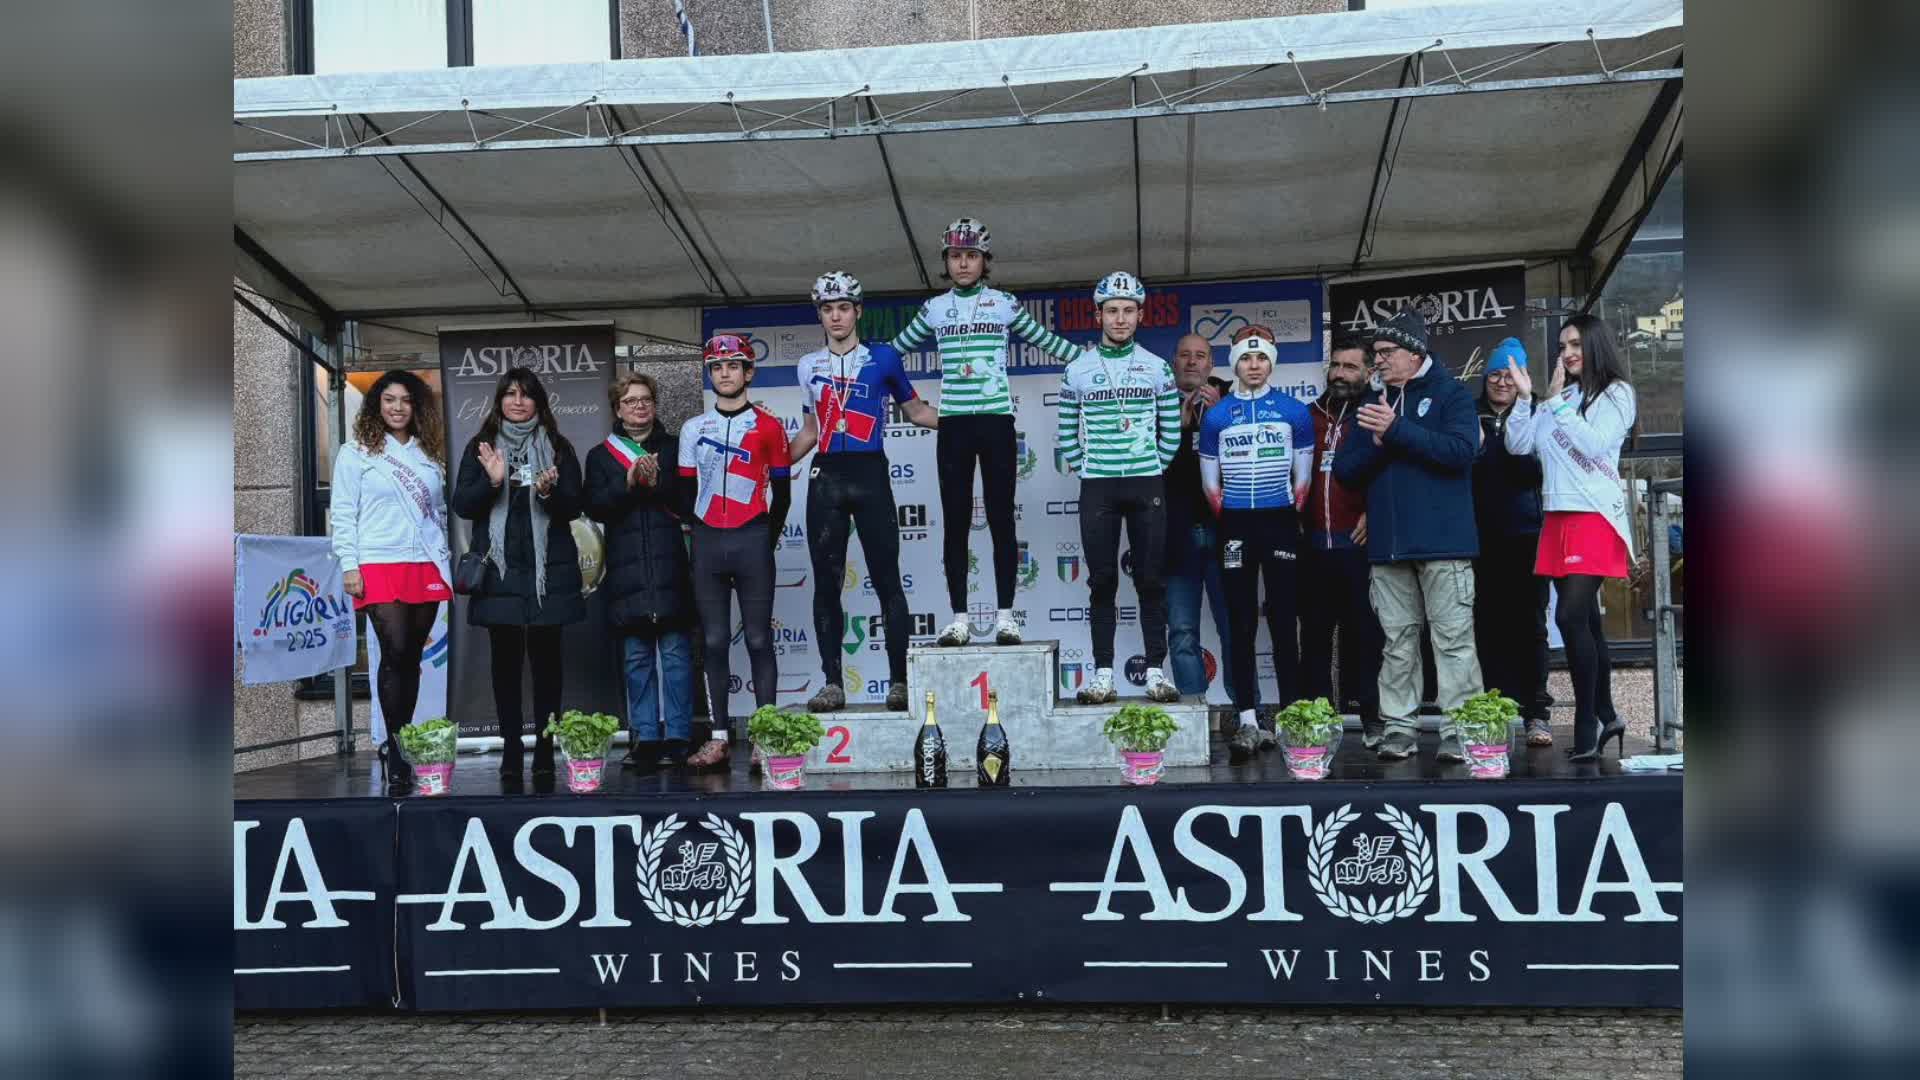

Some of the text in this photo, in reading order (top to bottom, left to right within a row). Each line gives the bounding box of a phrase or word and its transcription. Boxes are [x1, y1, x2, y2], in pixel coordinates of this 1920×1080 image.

[1112, 277, 1130, 290] 41
[286, 628, 328, 652] 2025
[970, 672, 990, 710] 1
[826, 726, 851, 763] 2
[923, 735, 936, 787] ASTORIA
[410, 808, 990, 932] ASTORIA
[1065, 802, 1682, 924] ASTORIA
[591, 950, 802, 985] WINES
[1260, 949, 1493, 982] WINES
